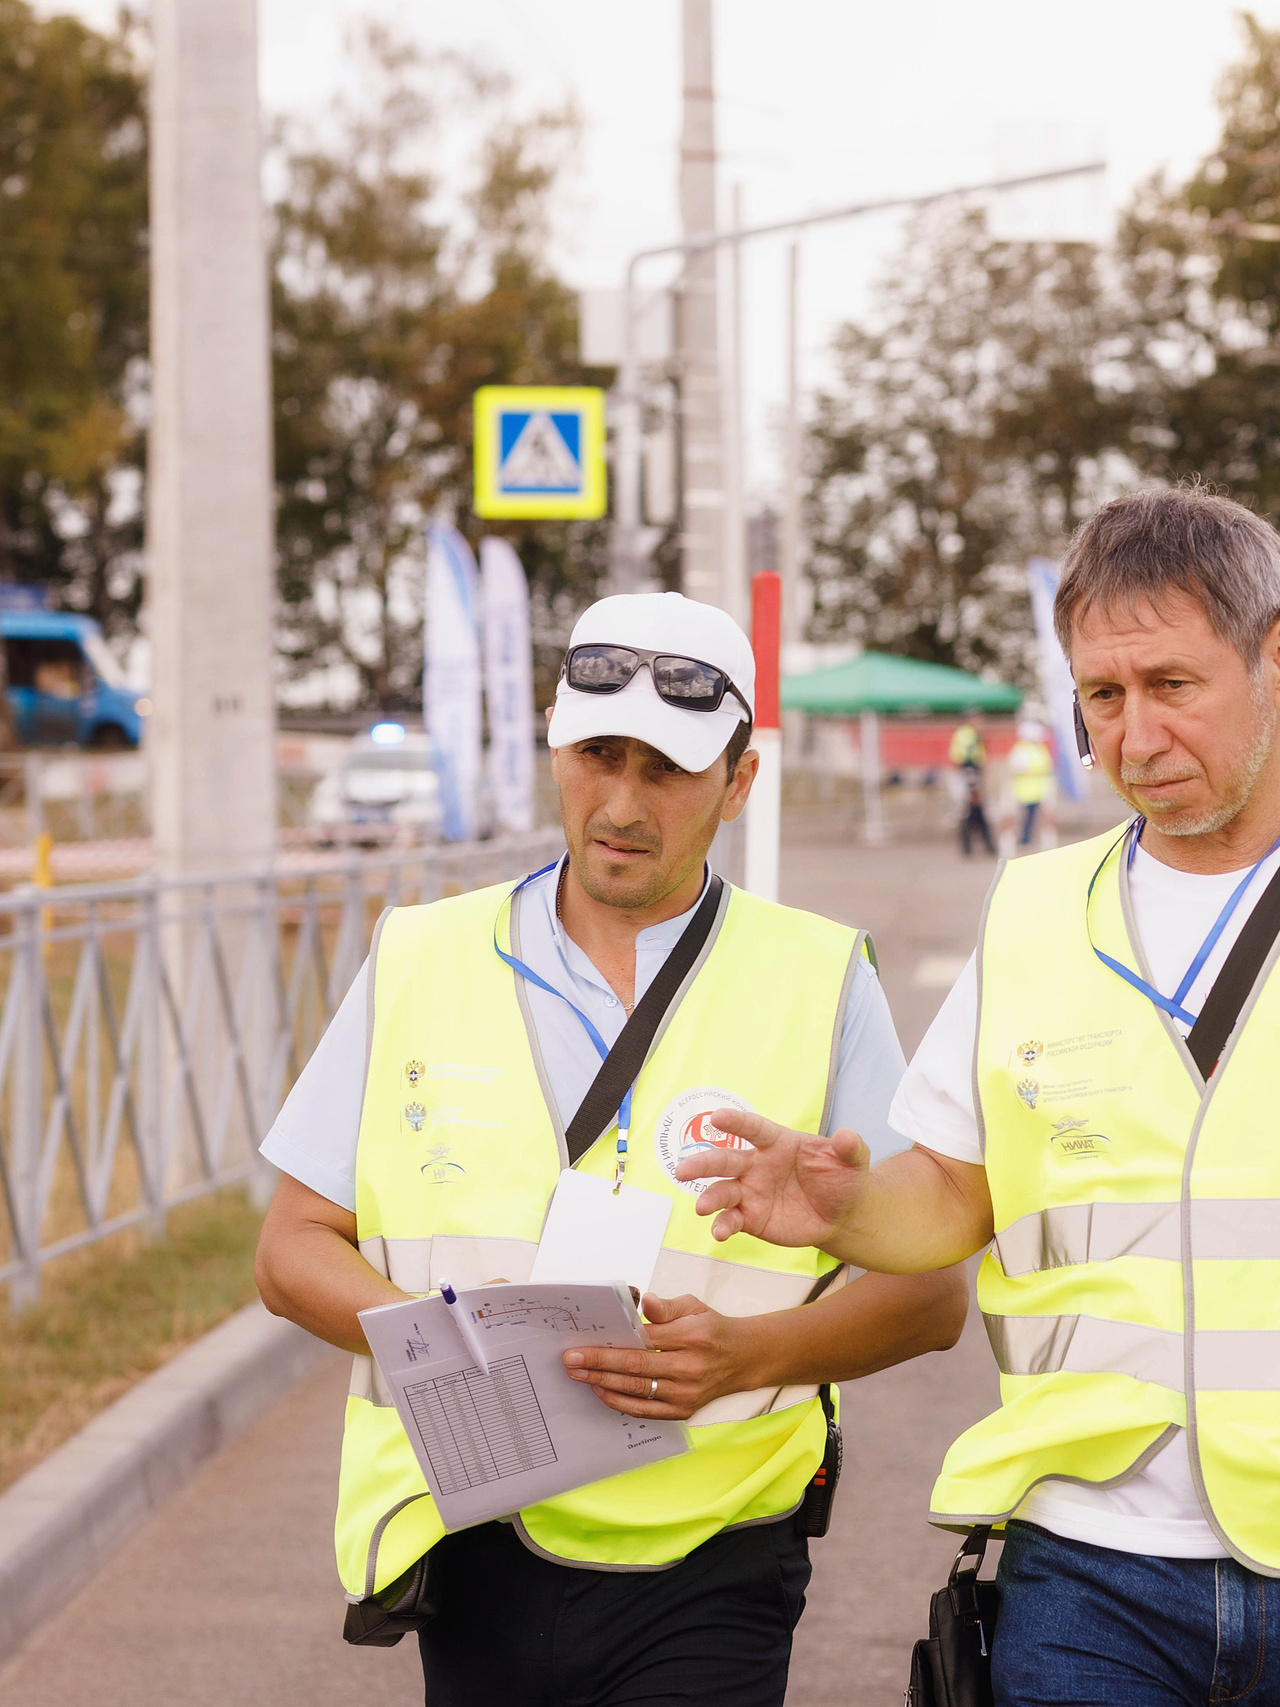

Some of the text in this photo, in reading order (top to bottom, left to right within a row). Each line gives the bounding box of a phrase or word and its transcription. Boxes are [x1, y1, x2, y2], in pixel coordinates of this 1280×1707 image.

[1086, 1029, 1123, 1041] ТРАНСПОРТА
[678, 1090, 731, 1108] ВСЕРОССИЙСКИЙ
[627, 1435, 662, 1449] Berlingo
